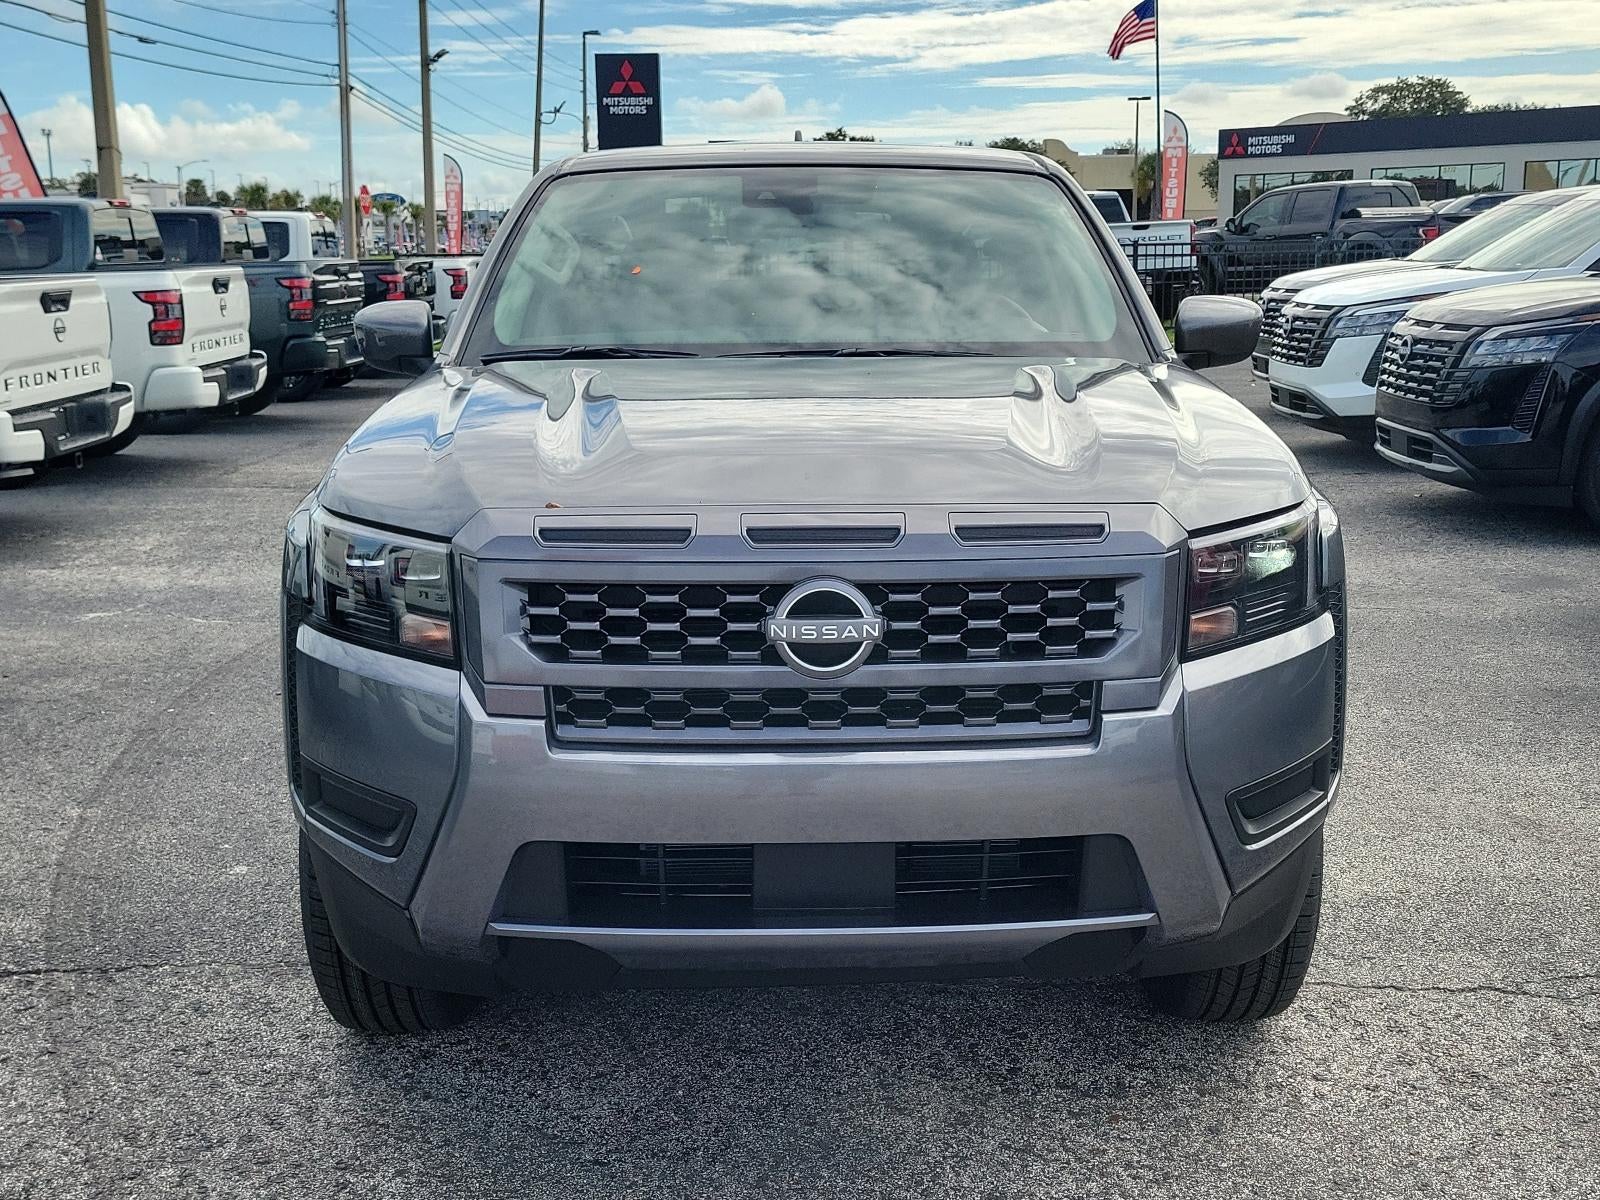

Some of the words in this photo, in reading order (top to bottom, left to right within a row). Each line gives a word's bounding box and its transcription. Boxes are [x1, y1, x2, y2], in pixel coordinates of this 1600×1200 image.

[602, 97, 653, 106] MITSUBISHI
[609, 106, 647, 115] MOTORS
[1247, 134, 1295, 146] MITSUBISHI
[1247, 145, 1283, 155] MOTORS
[1117, 234, 1184, 244] EVROLET
[191, 333, 244, 353] FRONTIER
[4, 361, 101, 391] FRONTIER
[770, 623, 879, 639] NISSAN
